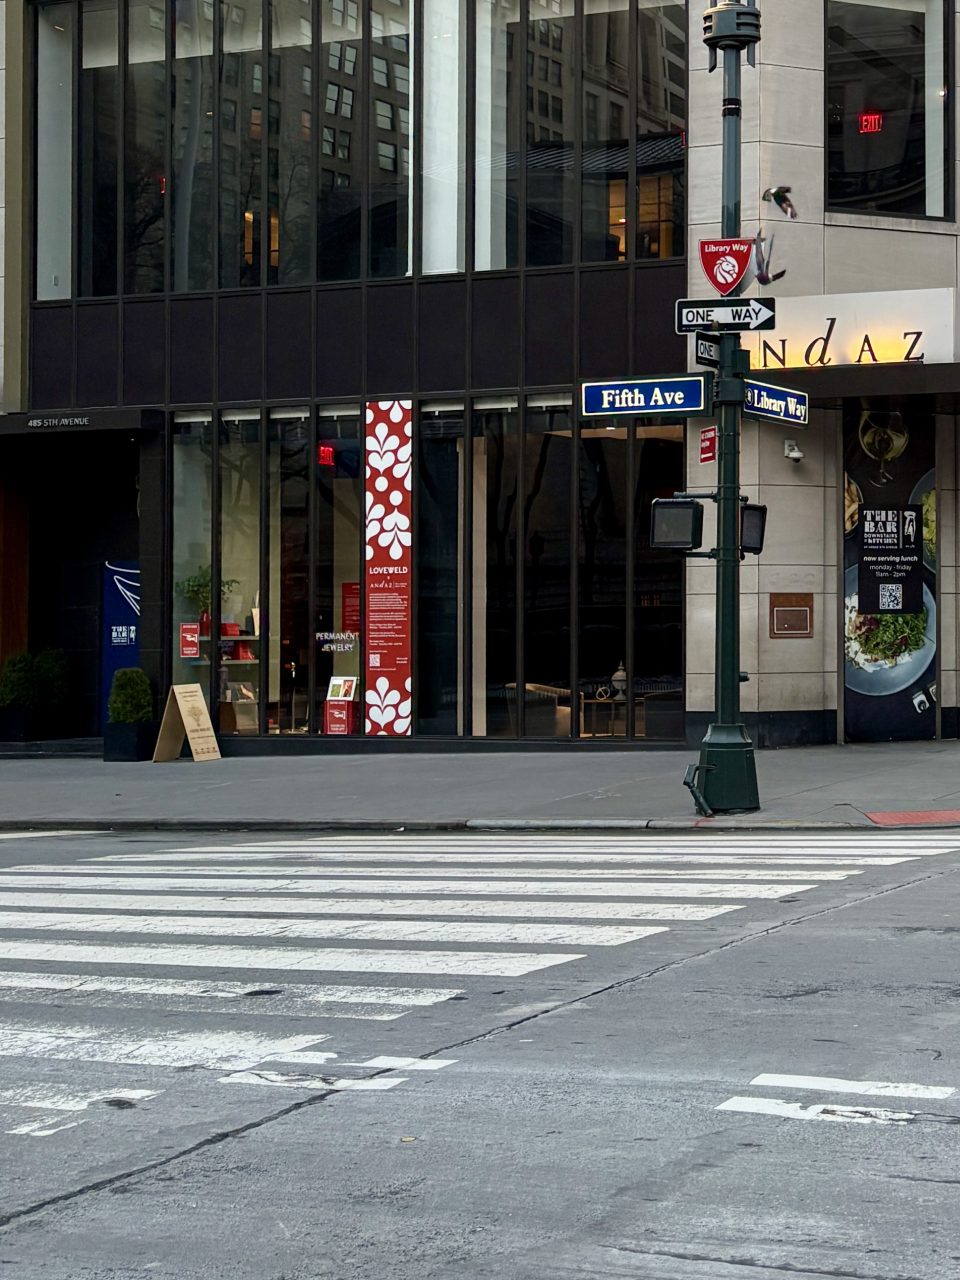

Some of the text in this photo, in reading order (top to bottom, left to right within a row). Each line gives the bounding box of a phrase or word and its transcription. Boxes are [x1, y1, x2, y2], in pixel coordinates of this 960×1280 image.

[862, 115, 880, 131] EXIT
[704, 243, 748, 253] Library Way
[685, 308, 762, 323] ONE WAY
[762, 318, 925, 368] NdAZ
[700, 342, 714, 358] ONE
[601, 387, 684, 408] Fifth Ave
[753, 389, 806, 421] Library Way
[28, 417, 90, 427] 485 5TH AVENUE
[863, 510, 898, 521] THE
[864, 521, 898, 533] BAR
[878, 555, 900, 563] serving
[369, 566, 408, 574] LOVEWELD
[315, 632, 359, 640] PERMANENT
[322, 643, 353, 651] JEWELRY
